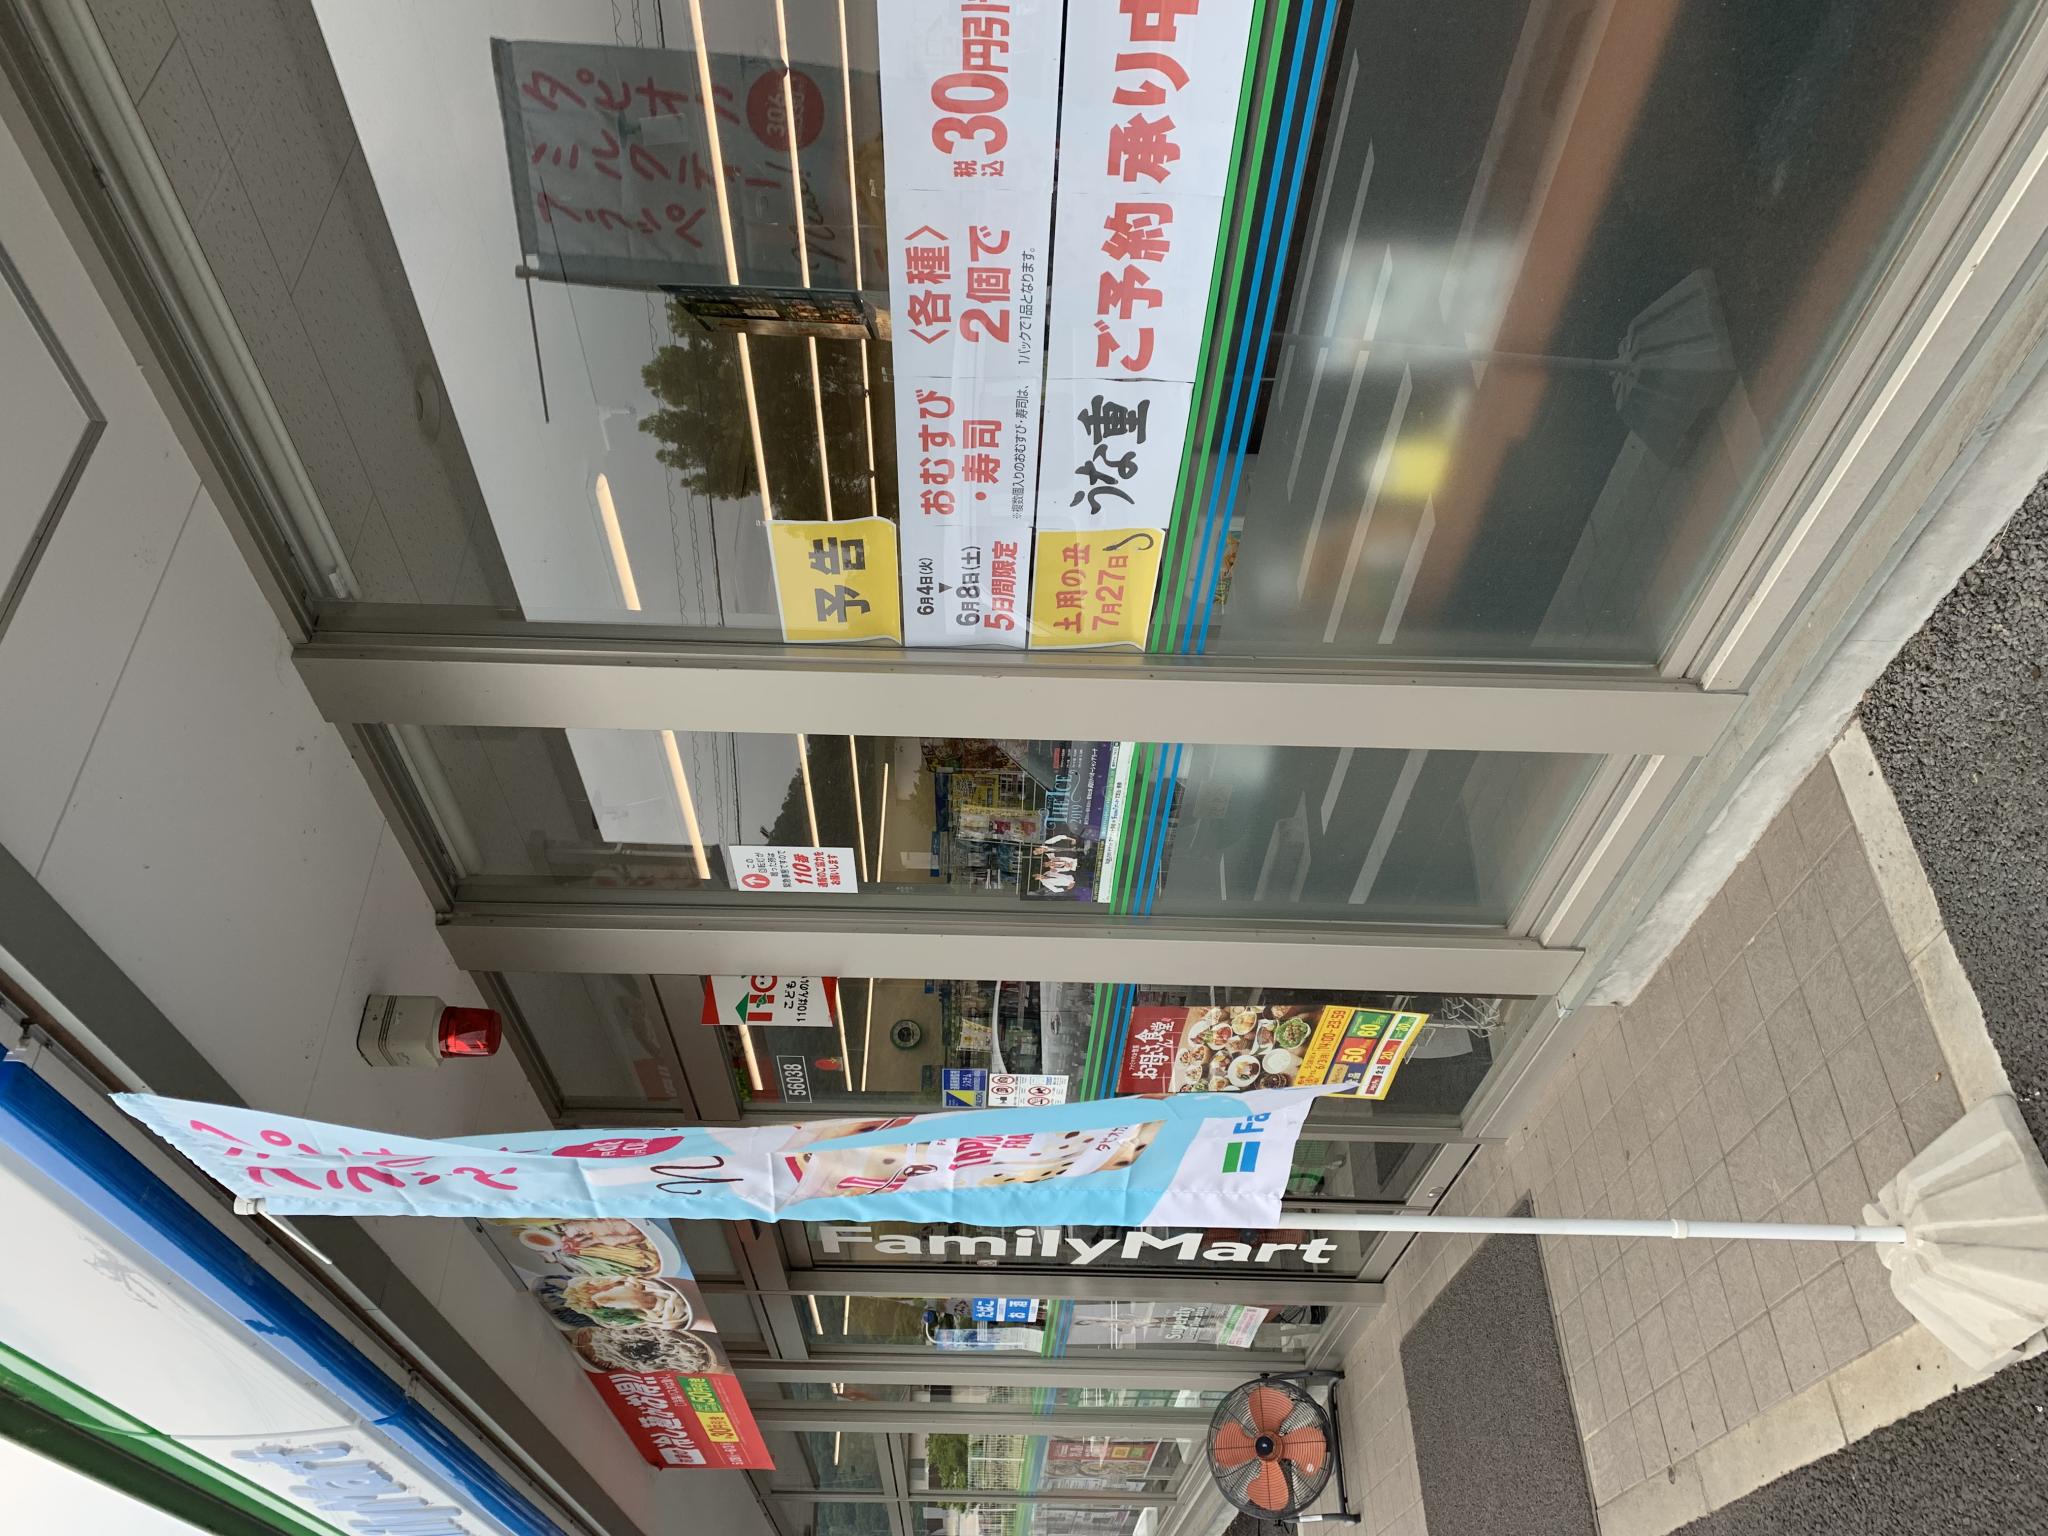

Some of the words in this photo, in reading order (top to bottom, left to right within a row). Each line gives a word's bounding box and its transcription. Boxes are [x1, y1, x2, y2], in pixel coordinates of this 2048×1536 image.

[930, 0, 1011, 155] 30円引
[953, 160, 1005, 178] 税込
[538, 193, 708, 249] フラッペ
[959, 224, 1011, 344] 2個で
[1095, 200, 1176, 373] ご予約
[915, 388, 957, 516] おむすび
[1068, 394, 1151, 516] うな重
[808, 537, 871, 624] 予告
[916, 557, 935, 616] 6月4日(火)
[955, 545, 982, 627] 6月8日(土)
[983, 540, 1018, 631] 5日間限定
[1053, 542, 1092, 634] 土用の丑
[1091, 555, 1130, 632] 7月27日
[1045, 774, 1073, 797] ICE
[1069, 804, 1083, 824] 2019
[791, 853, 814, 884] 110番
[783, 980, 797, 1010] こども
[783, 1063, 807, 1096] 56038
[1131, 1021, 1175, 1080] お母さん食堂
[1340, 1047, 1367, 1063] 50
[819, 1224, 1340, 1265] FamilyMart
[975, 1300, 995, 1318] たばこ
[1164, 1305, 1195, 1340] Superfly
